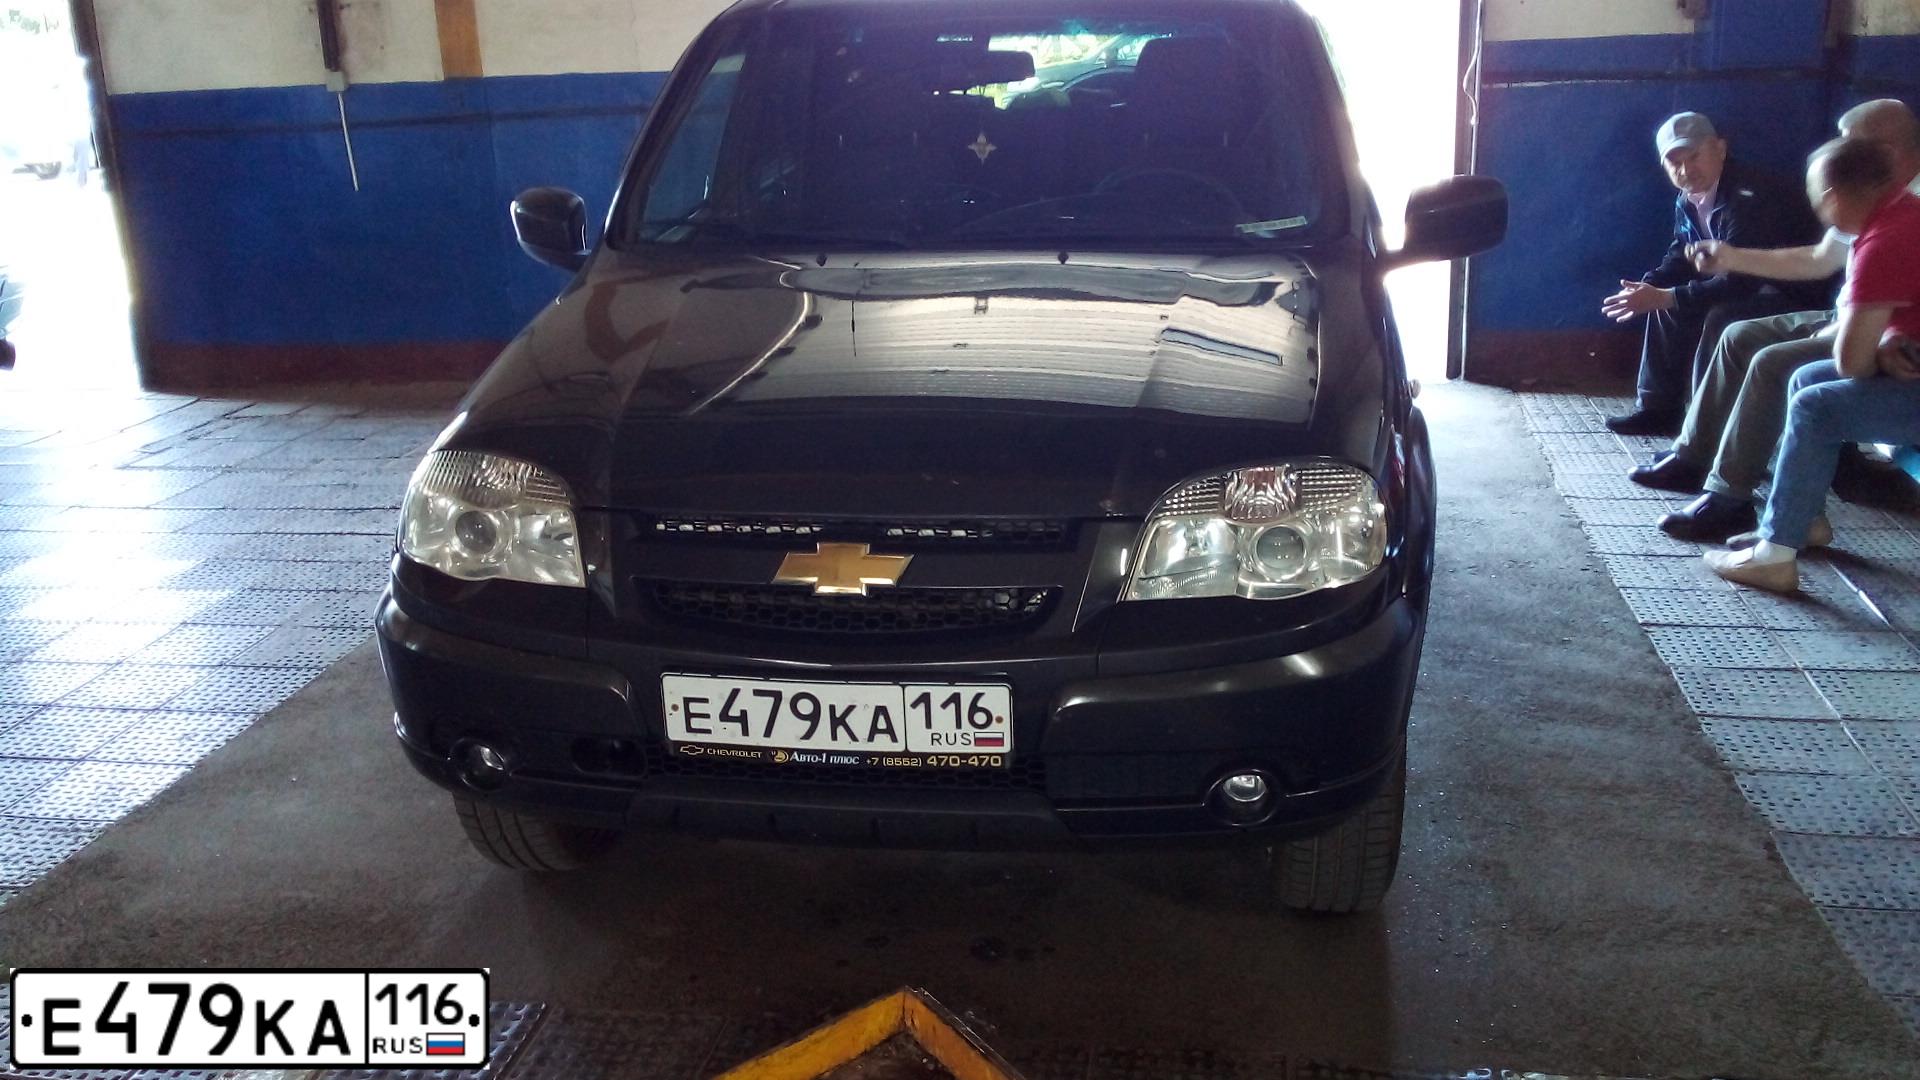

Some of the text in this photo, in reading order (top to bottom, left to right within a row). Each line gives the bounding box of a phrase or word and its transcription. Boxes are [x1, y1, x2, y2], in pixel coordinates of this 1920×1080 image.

[909, 691, 994, 730] 116
[930, 732, 972, 747] RUS
[706, 748, 762, 759] CHEVROLET
[866, 757, 879, 766] +7
[926, 755, 1001, 767] 470-470
